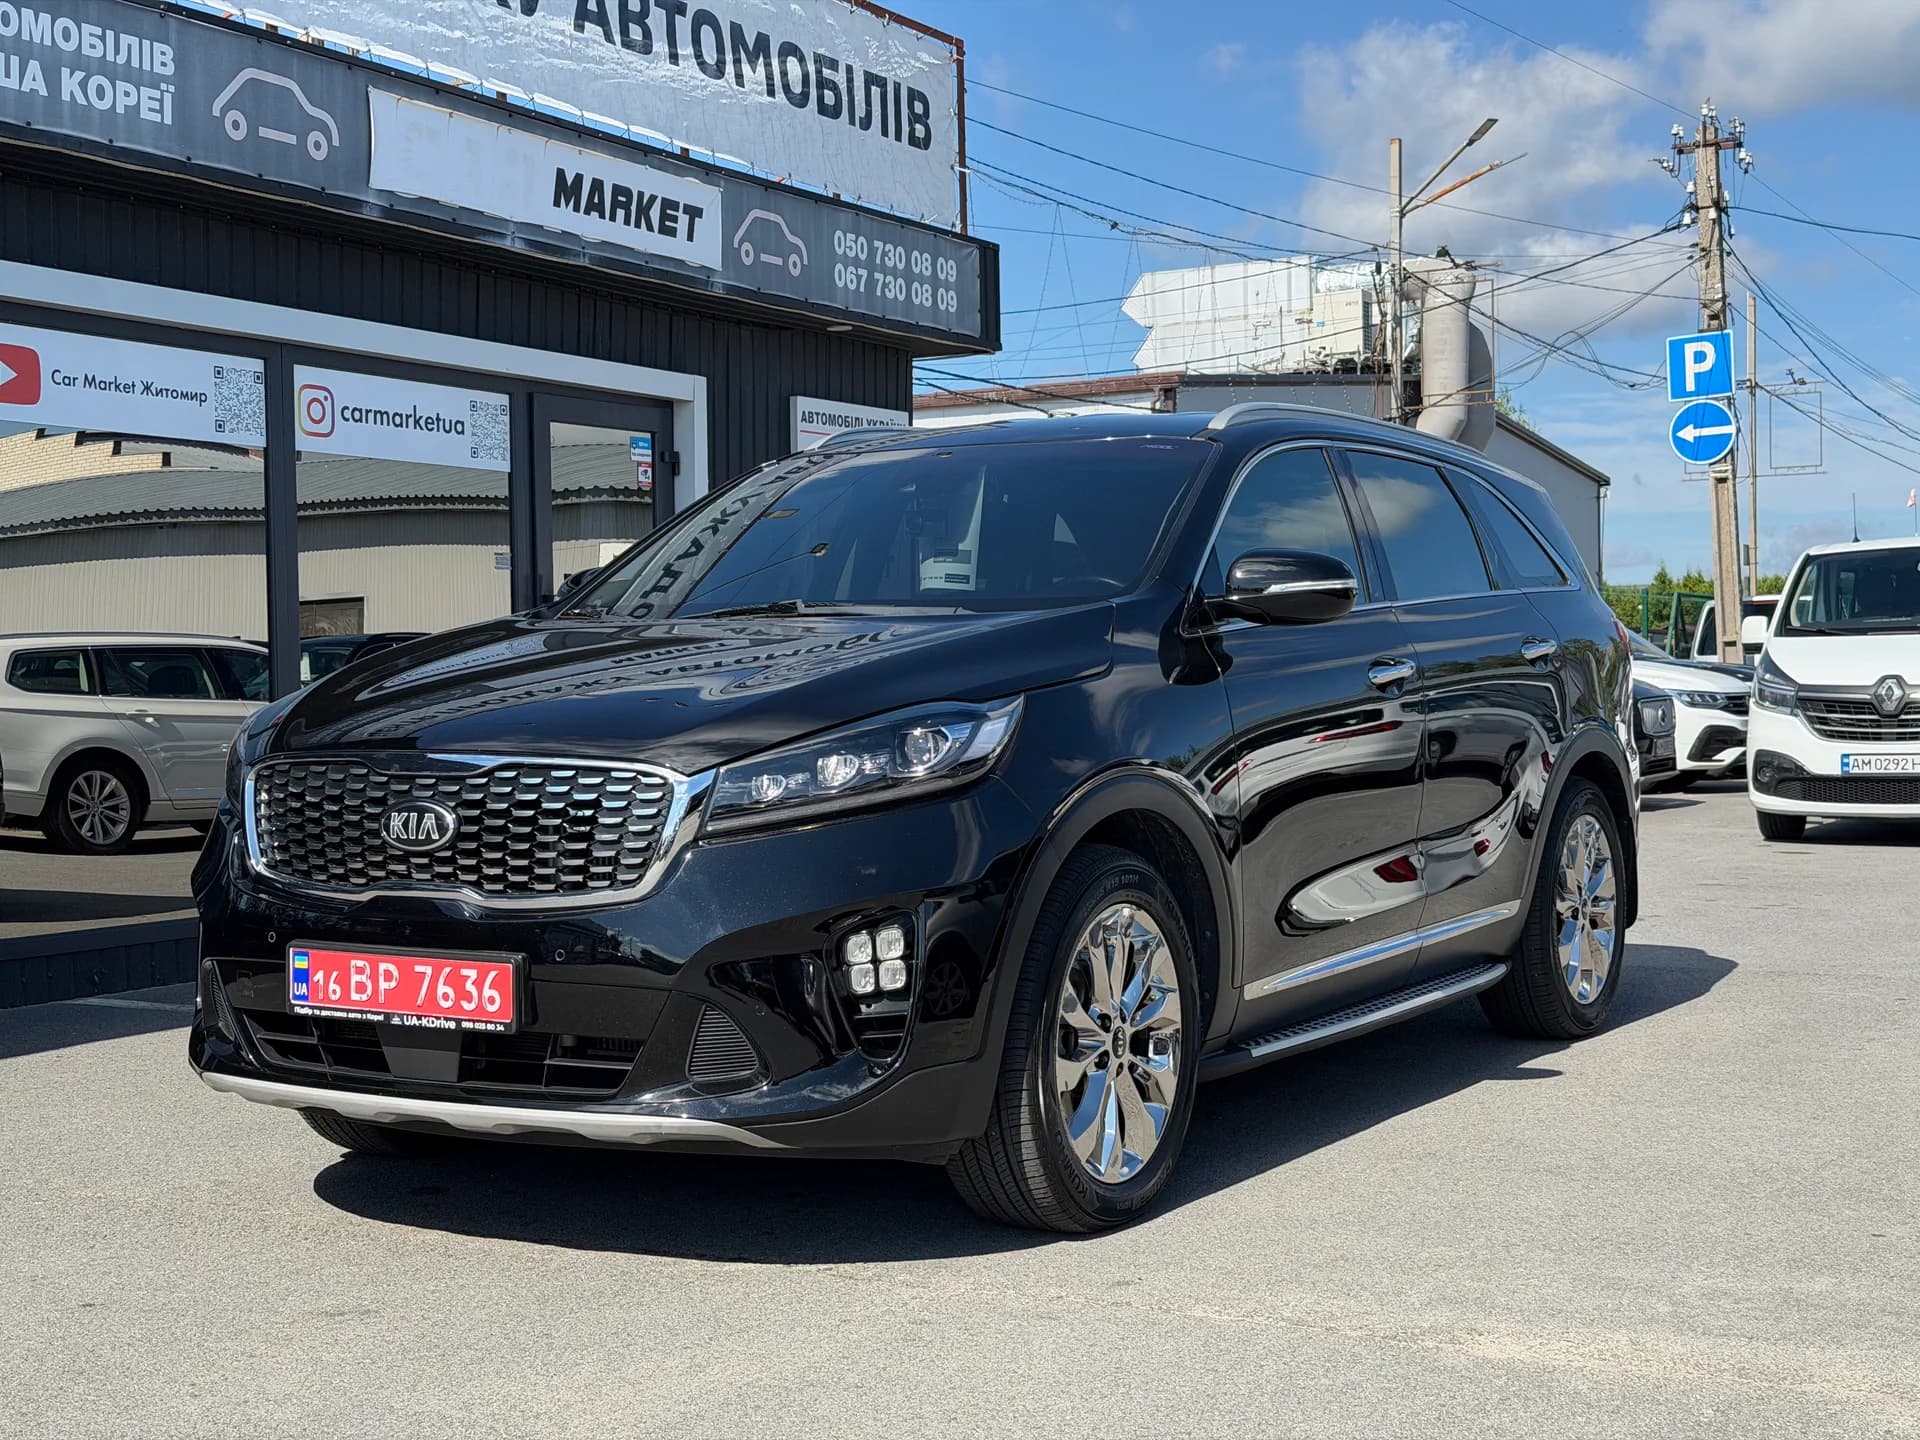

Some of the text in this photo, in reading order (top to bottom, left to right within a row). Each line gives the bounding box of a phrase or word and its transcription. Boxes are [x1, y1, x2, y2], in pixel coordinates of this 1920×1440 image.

[61, 67, 176, 125] КОРЕЇ
[574, 0, 932, 151] АВТОМОБІЛІВ
[552, 167, 704, 243] MARKET
[834, 230, 957, 282] 050 730 08 09
[834, 263, 957, 313] 067 730 08 09
[51, 369, 208, 407] Car Market Житомир
[1684, 341, 1716, 392] P
[340, 404, 465, 436] carmarketua
[800, 410, 864, 429] АВТОМОБІЛІ
[1851, 758, 1872, 771] AM
[1874, 758, 1909, 771] 0292
[390, 812, 440, 839] KIA
[294, 982, 308, 996] UA
[313, 970, 342, 1001] 16
[413, 964, 502, 1013] 7636
[403, 1015, 457, 1029] UA-KDrive
